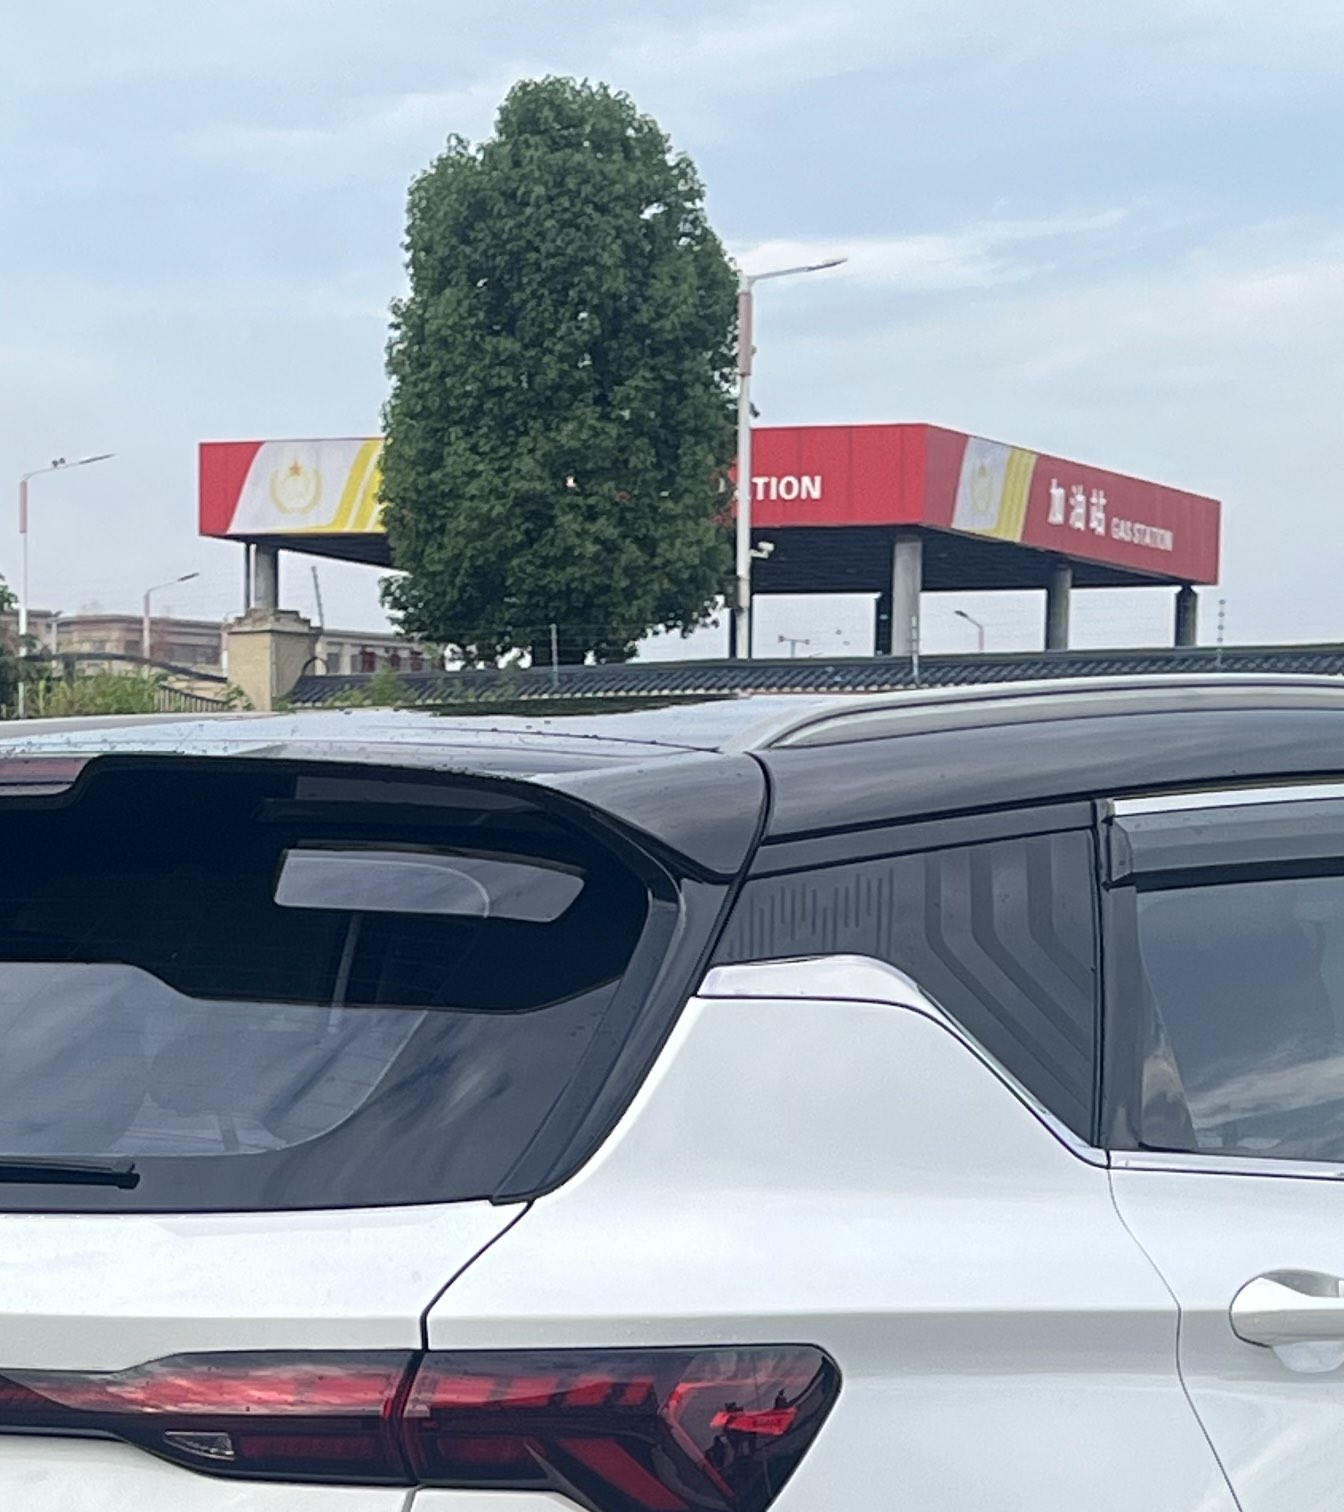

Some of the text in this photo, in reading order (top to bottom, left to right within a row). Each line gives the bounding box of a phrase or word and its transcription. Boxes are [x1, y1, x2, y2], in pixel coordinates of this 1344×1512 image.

[734, 475, 822, 501] TION
[1048, 478, 1107, 536] 加油站
